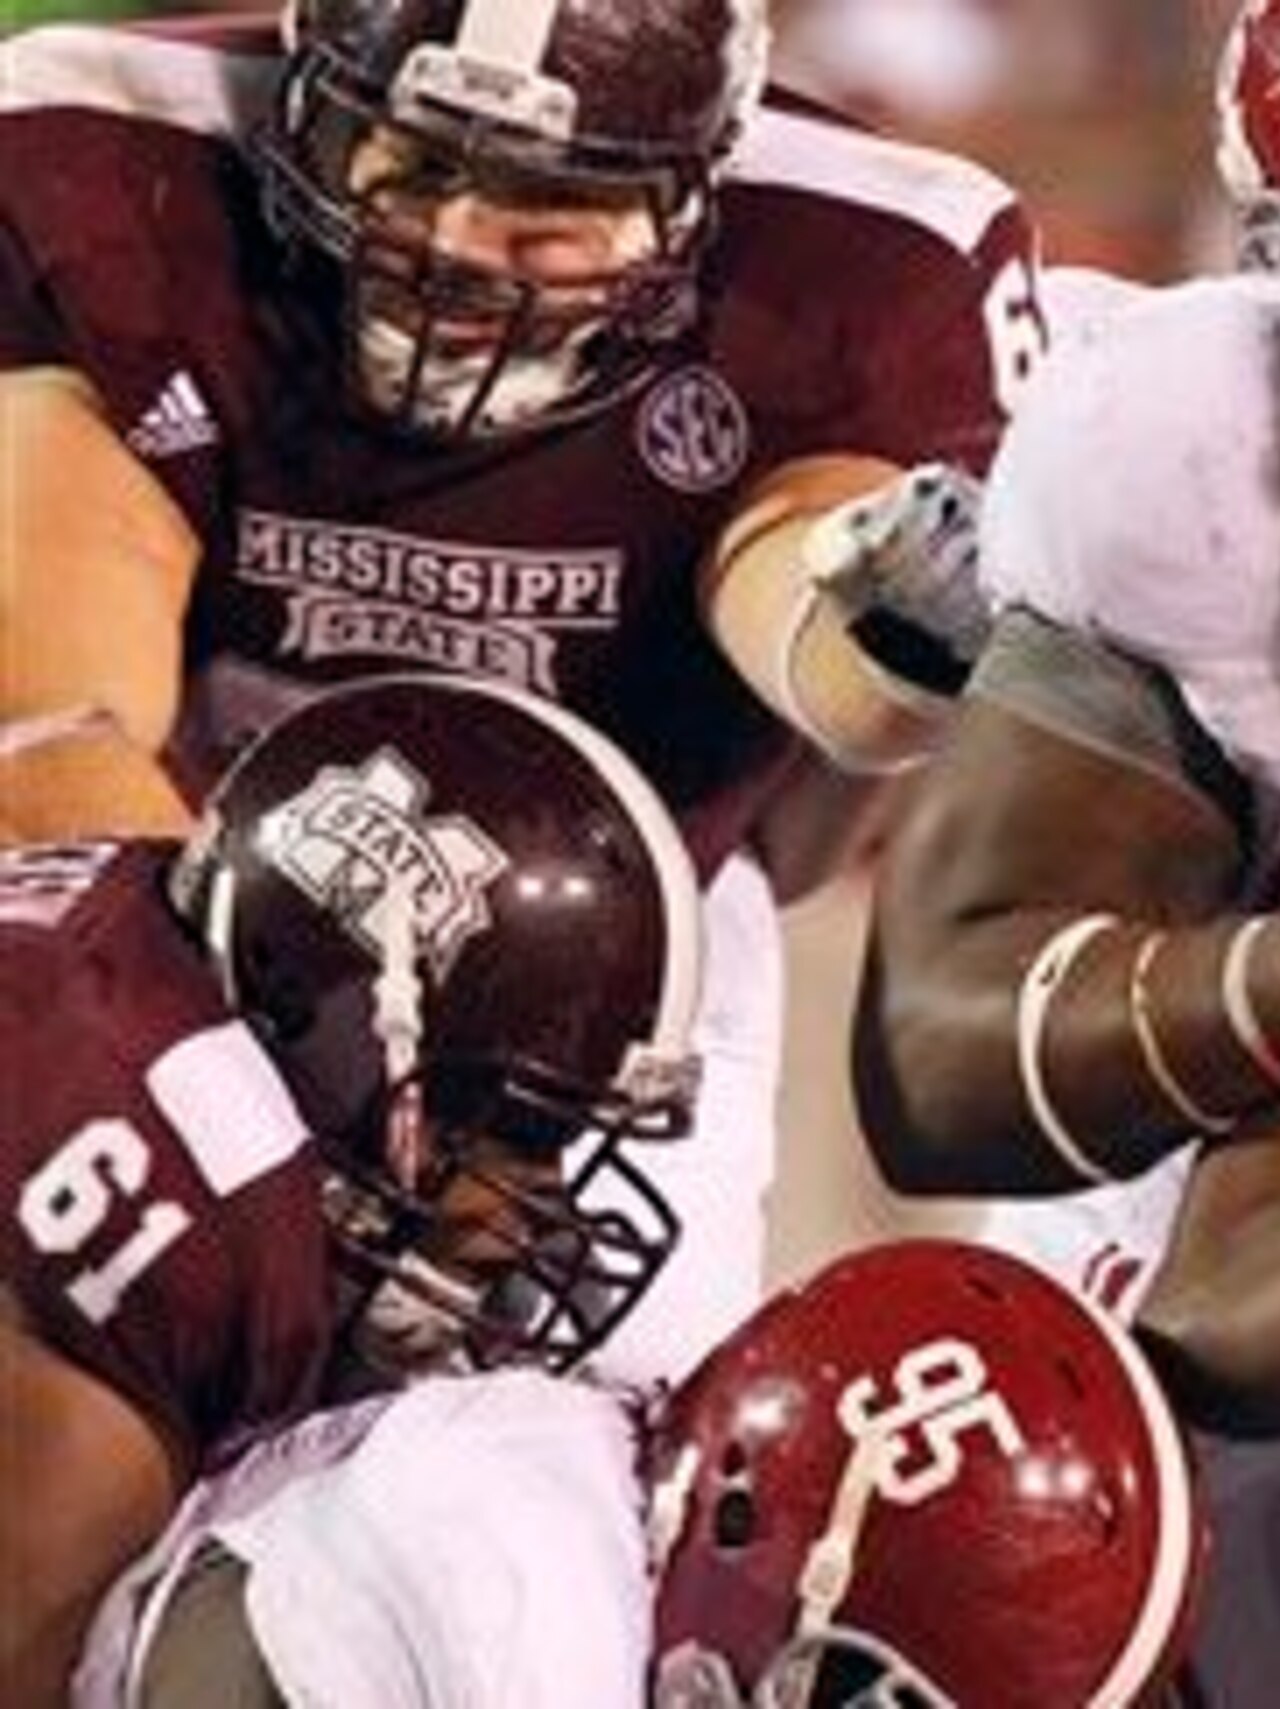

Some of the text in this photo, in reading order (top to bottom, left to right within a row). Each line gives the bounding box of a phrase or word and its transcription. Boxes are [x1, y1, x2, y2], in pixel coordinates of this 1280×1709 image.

[238, 513, 621, 615] MISSISSIPPI
[326, 800, 448, 915] STATE
[18, 1118, 194, 1325] 61
[836, 1337, 1028, 1505] 95
